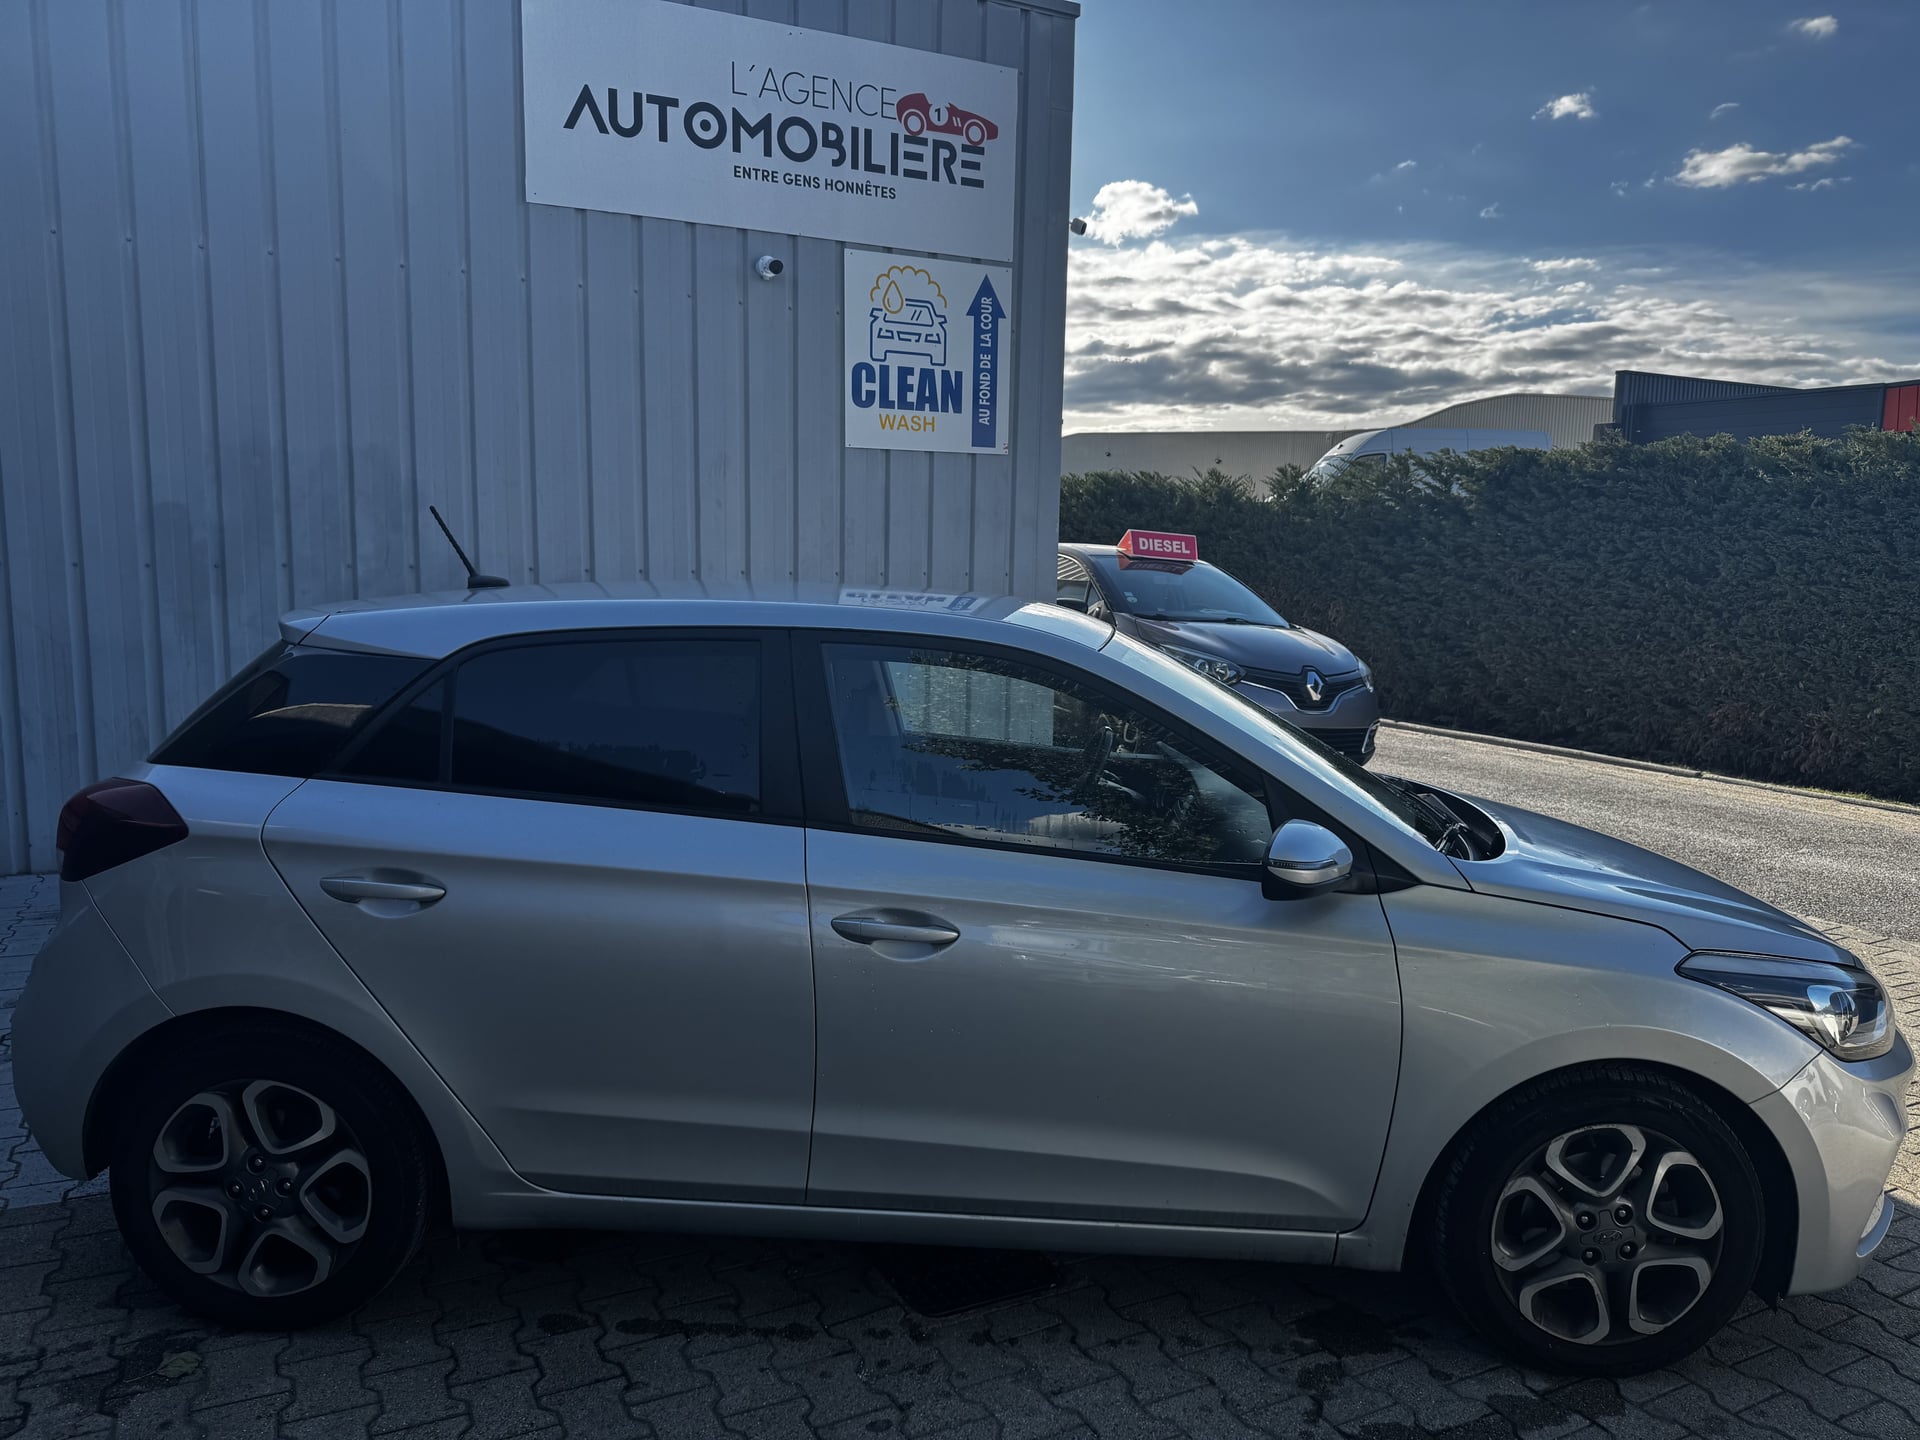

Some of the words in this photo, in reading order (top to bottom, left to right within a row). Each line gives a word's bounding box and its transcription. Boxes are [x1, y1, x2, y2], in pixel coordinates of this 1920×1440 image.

[934, 107, 942, 122] 1
[733, 165, 779, 184] ENTRE
[782, 172, 821, 189] GENS
[824, 178, 897, 200] HONNÊTES
[980, 296, 993, 331] COUR
[980, 332, 992, 348] LA
[980, 353, 991, 369] DE
[851, 361, 963, 414] CLEAN
[978, 371, 991, 406] FOND
[878, 413, 936, 432] WASH
[978, 407, 991, 426] AU
[1138, 537, 1191, 554] DIESEL
